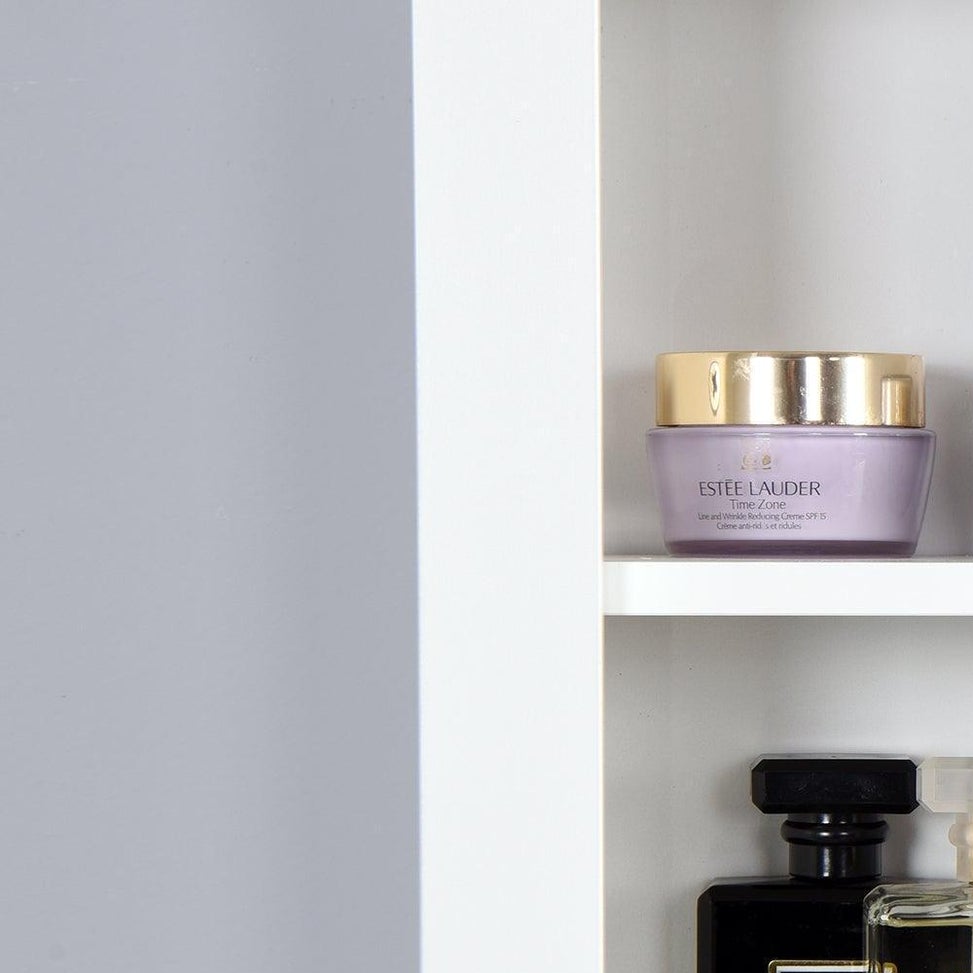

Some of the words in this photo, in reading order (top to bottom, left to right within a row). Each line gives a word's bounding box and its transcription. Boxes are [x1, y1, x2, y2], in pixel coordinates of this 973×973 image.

[749, 480, 821, 496] LAUDER
[729, 499, 755, 510] Time
[757, 499, 787, 510] Zone
[711, 511, 722, 520] and
[723, 511, 747, 520] Wrinkle
[748, 511, 779, 521] Reducing
[805, 511, 819, 520] SPF
[770, 521, 778, 530] et
